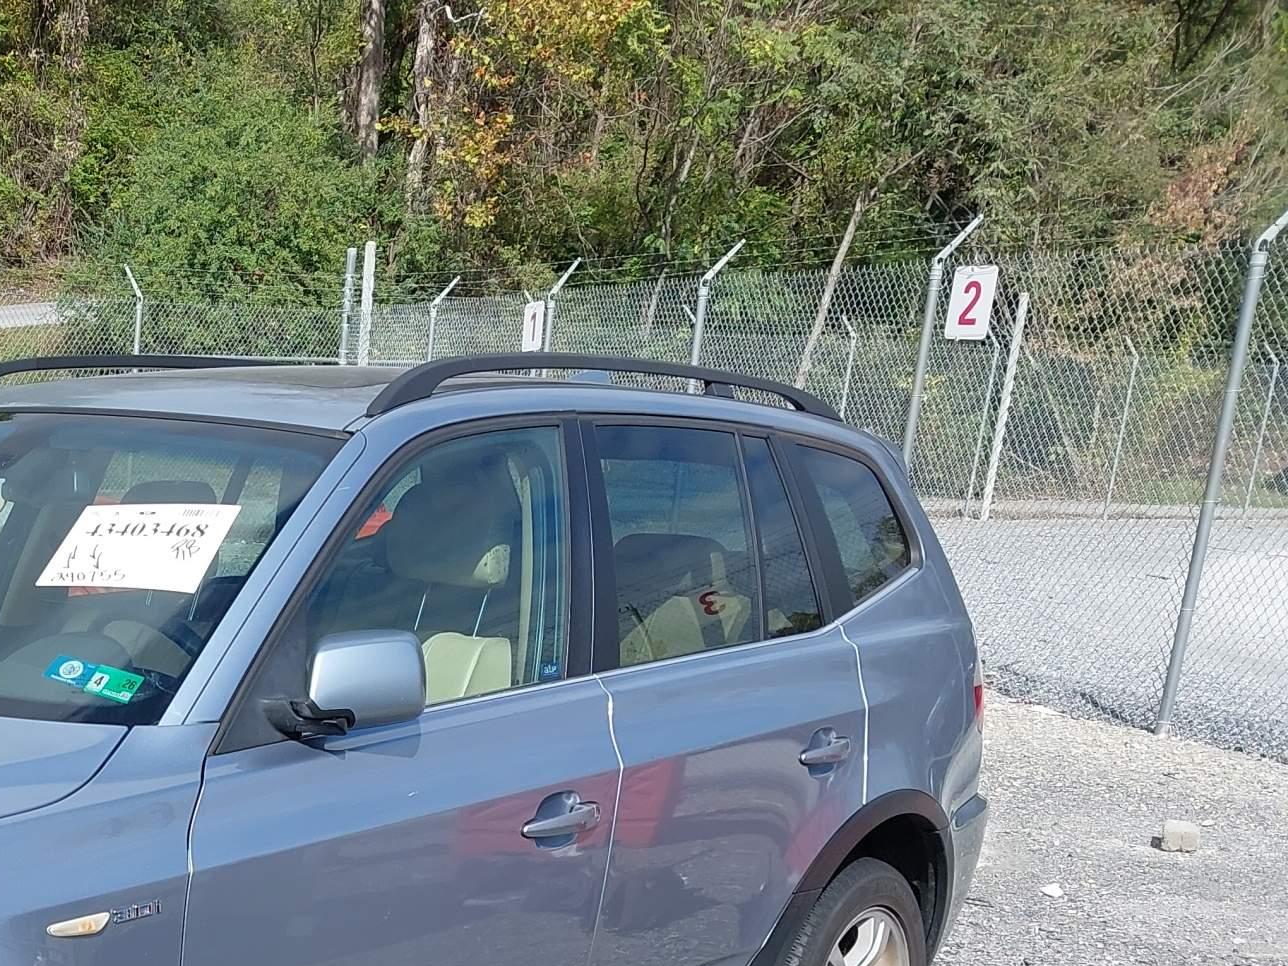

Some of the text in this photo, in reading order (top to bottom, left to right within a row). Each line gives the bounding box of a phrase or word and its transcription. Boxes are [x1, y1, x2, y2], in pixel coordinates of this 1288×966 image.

[957, 280, 982, 326] 2
[530, 311, 538, 342] 1
[85, 522, 209, 537] 43403468
[94, 675, 105, 687] 4
